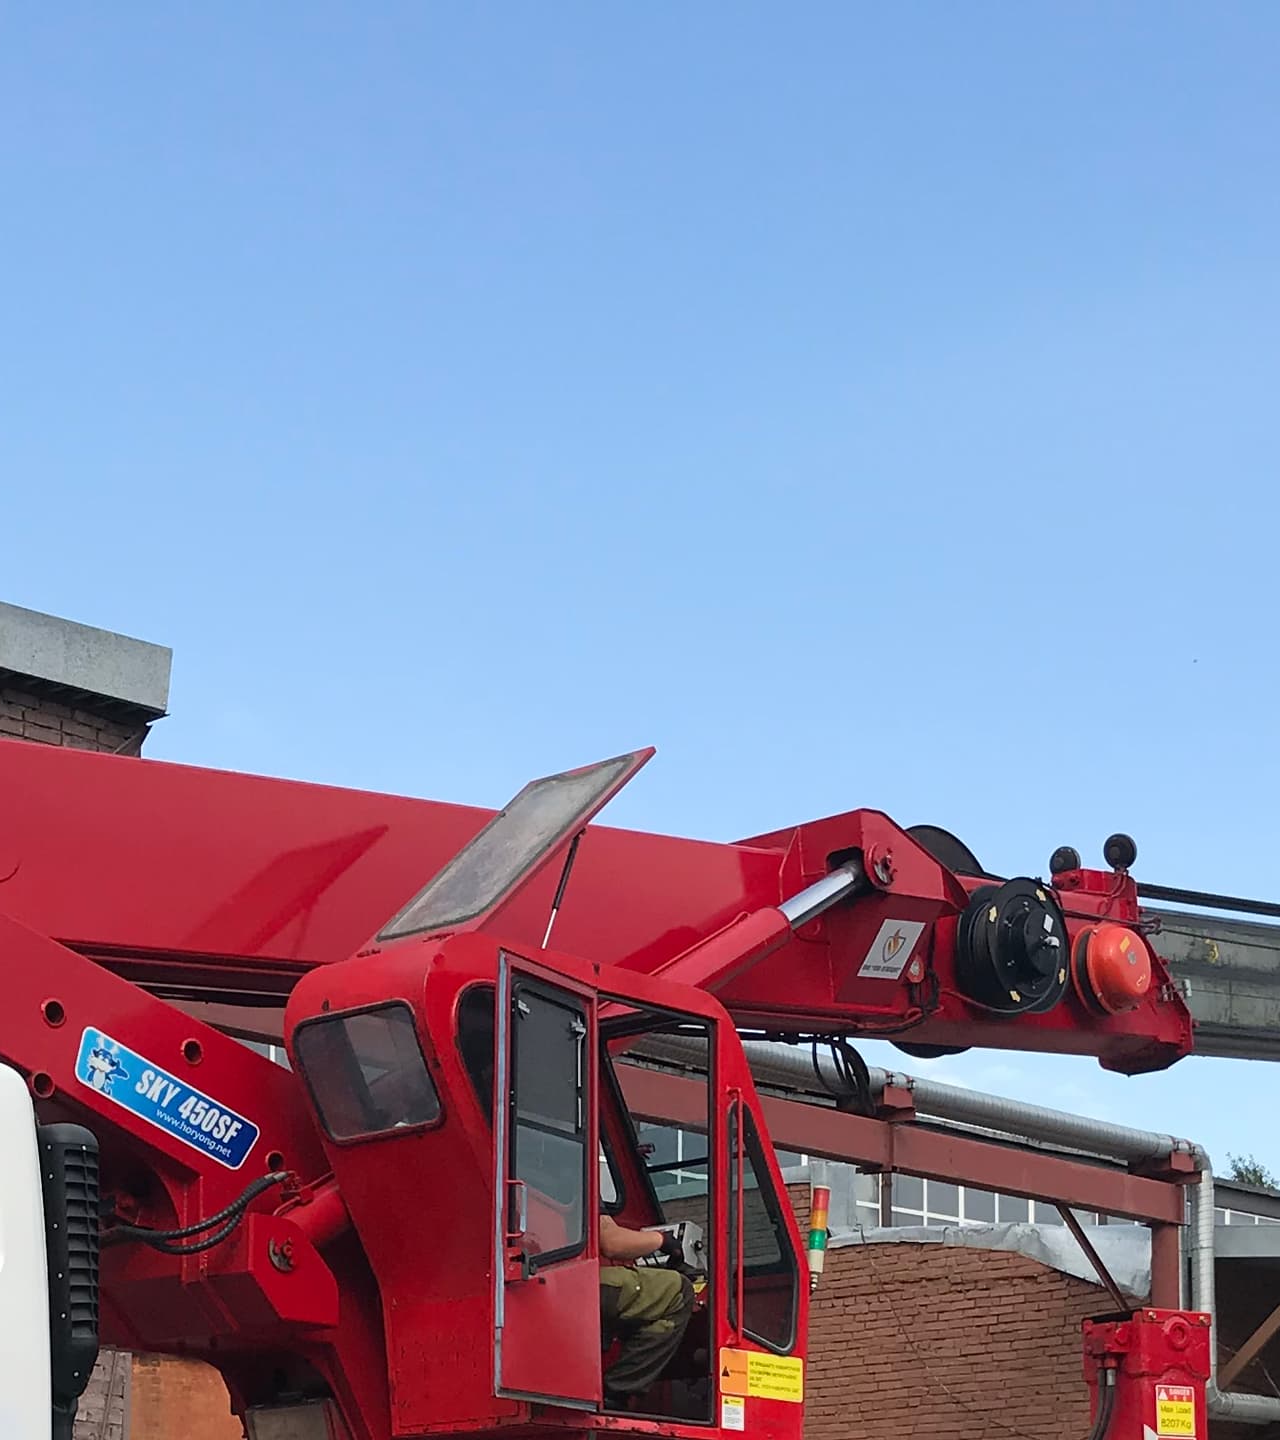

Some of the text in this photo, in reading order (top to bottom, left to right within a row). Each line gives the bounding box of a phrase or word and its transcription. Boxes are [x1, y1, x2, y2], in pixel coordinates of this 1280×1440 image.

[135, 1070, 242, 1144] SKY 450SF
[155, 1108, 232, 1158] www.horyong.net
